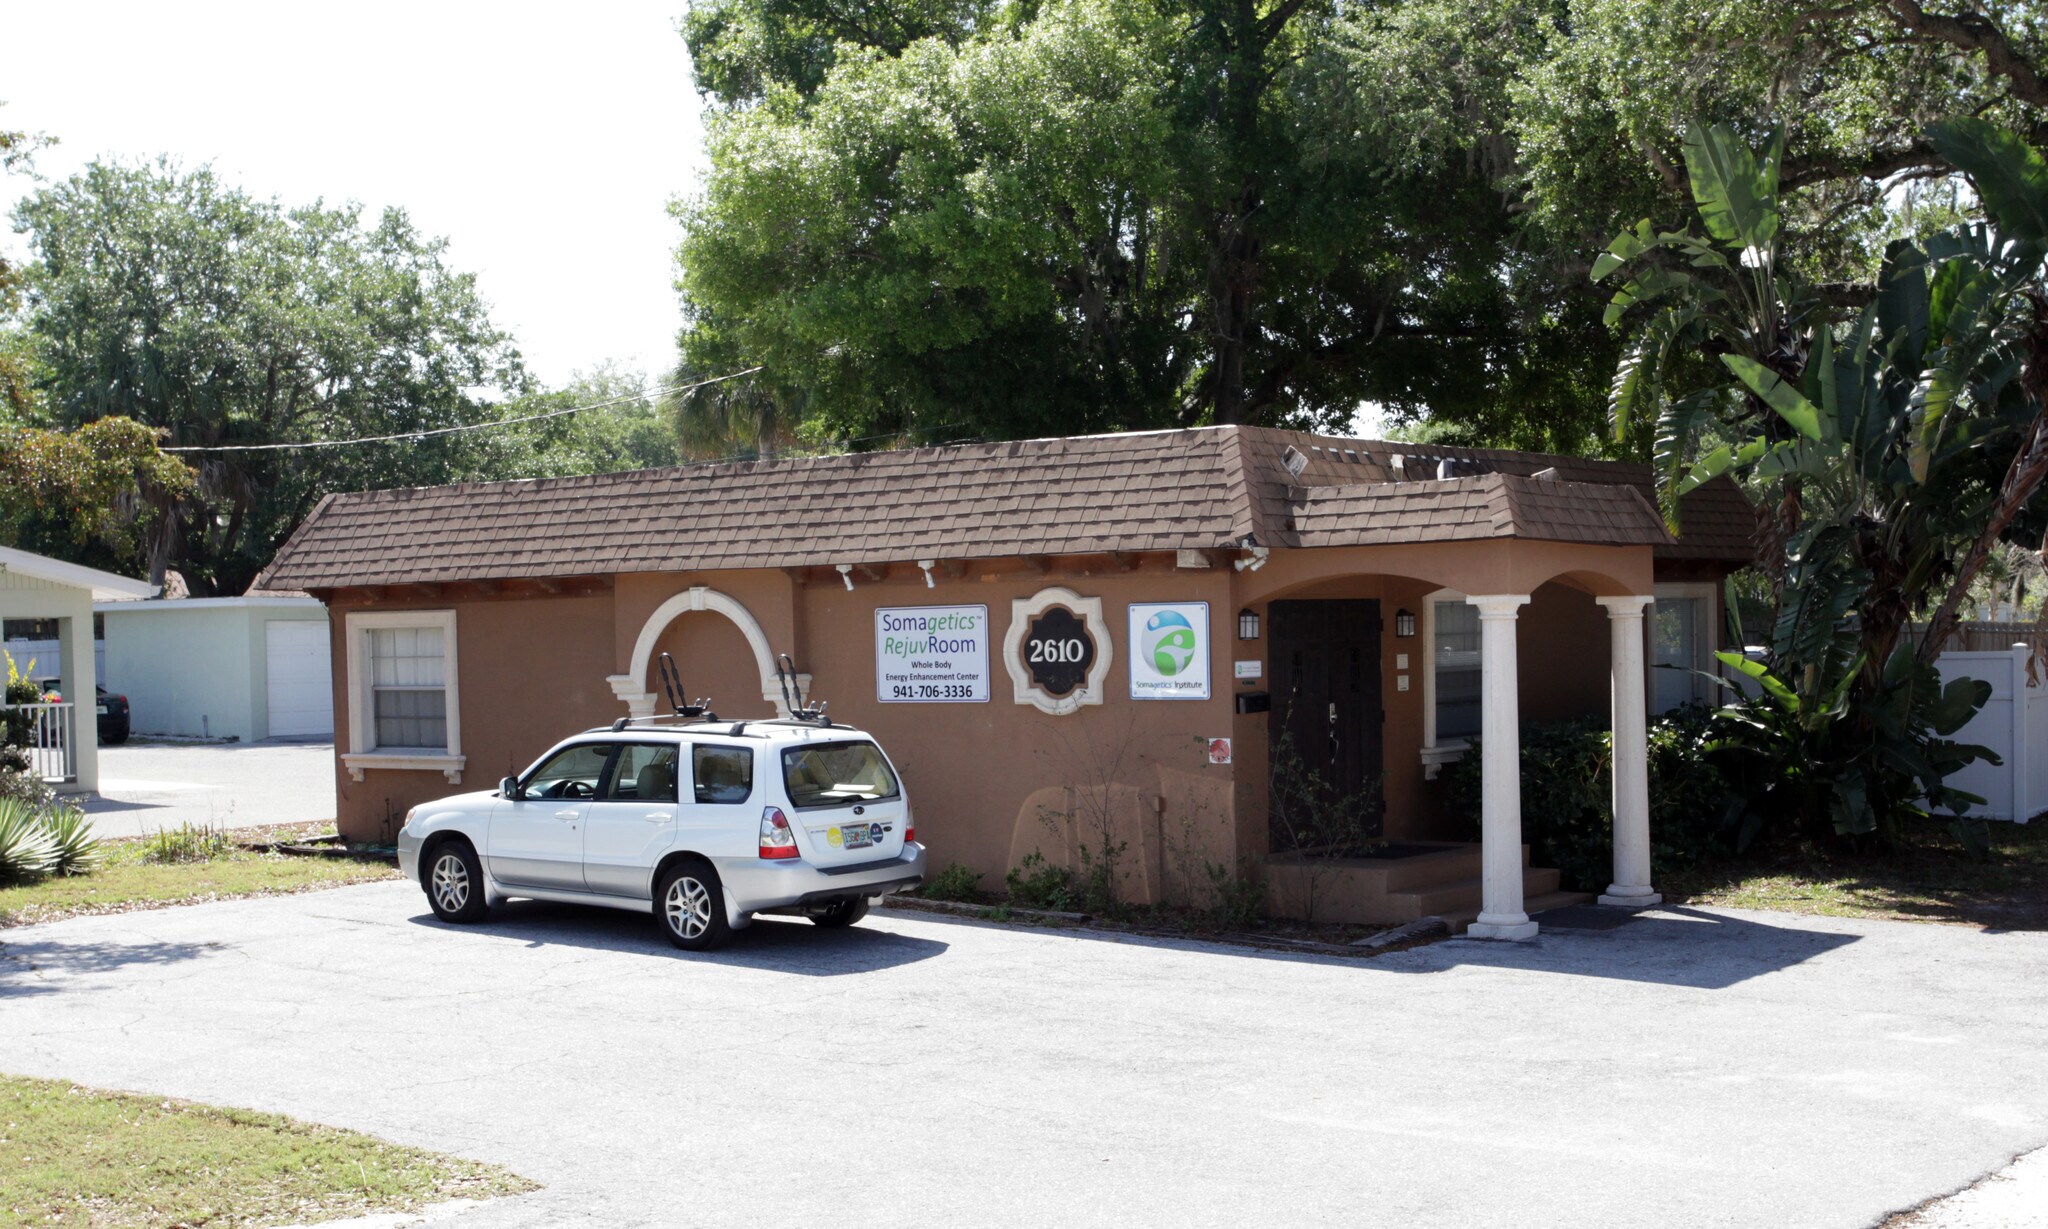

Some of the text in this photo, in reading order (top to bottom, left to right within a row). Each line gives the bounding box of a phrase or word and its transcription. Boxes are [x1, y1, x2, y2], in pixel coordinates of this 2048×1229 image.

[884, 636, 976, 659] RejuvRoom
[1030, 638, 1084, 663] 2610
[911, 660, 952, 670] Whole Body
[885, 672, 979, 682] Energy Enhancement Center
[1136, 680, 1203, 690] Somagetics Institute
[893, 685, 973, 698] 941-706-3336
